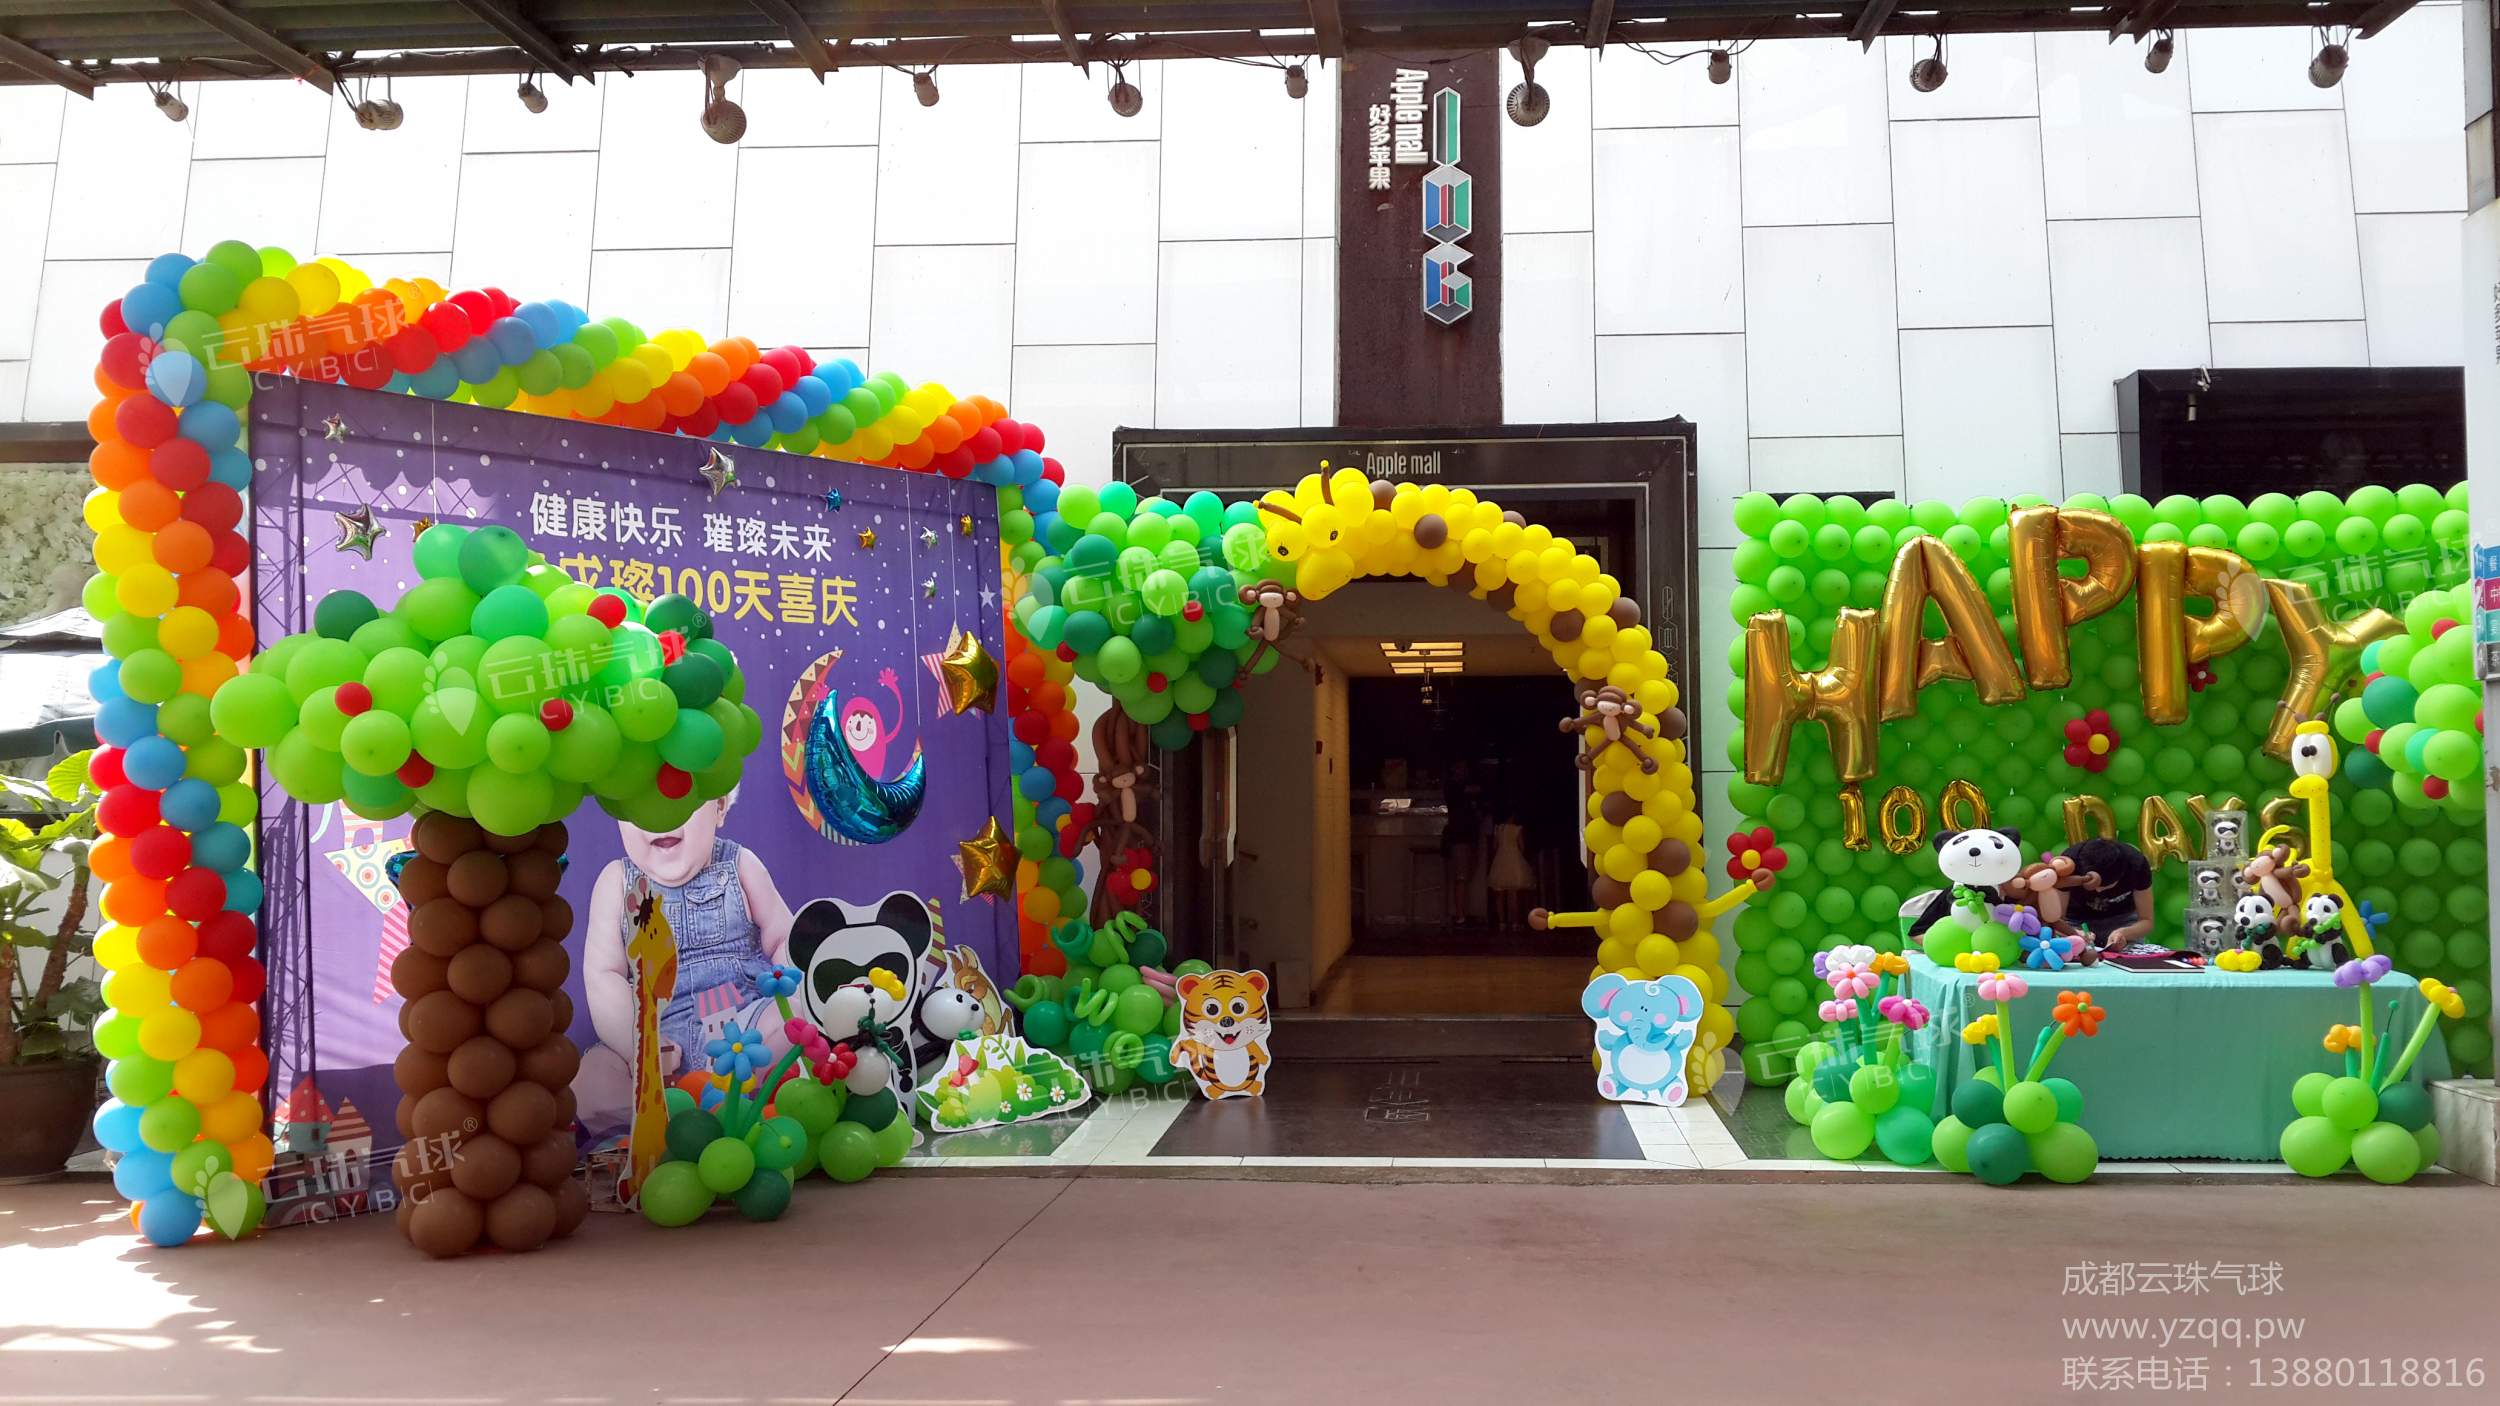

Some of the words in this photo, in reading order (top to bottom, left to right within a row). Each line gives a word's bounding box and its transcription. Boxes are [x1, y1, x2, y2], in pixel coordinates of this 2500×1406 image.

[1390, 68, 1430, 122] Apple
[1368, 104, 1392, 190] 好多苹果
[1394, 124, 1429, 165] mall
[1366, 451, 1407, 478] Apple
[1410, 450, 1441, 475] mall
[530, 491, 683, 549] 健康快乐
[702, 511, 833, 563] 璀璨未来
[1743, 503, 2408, 787] HAPPY
[1838, 779, 1992, 855] 100
